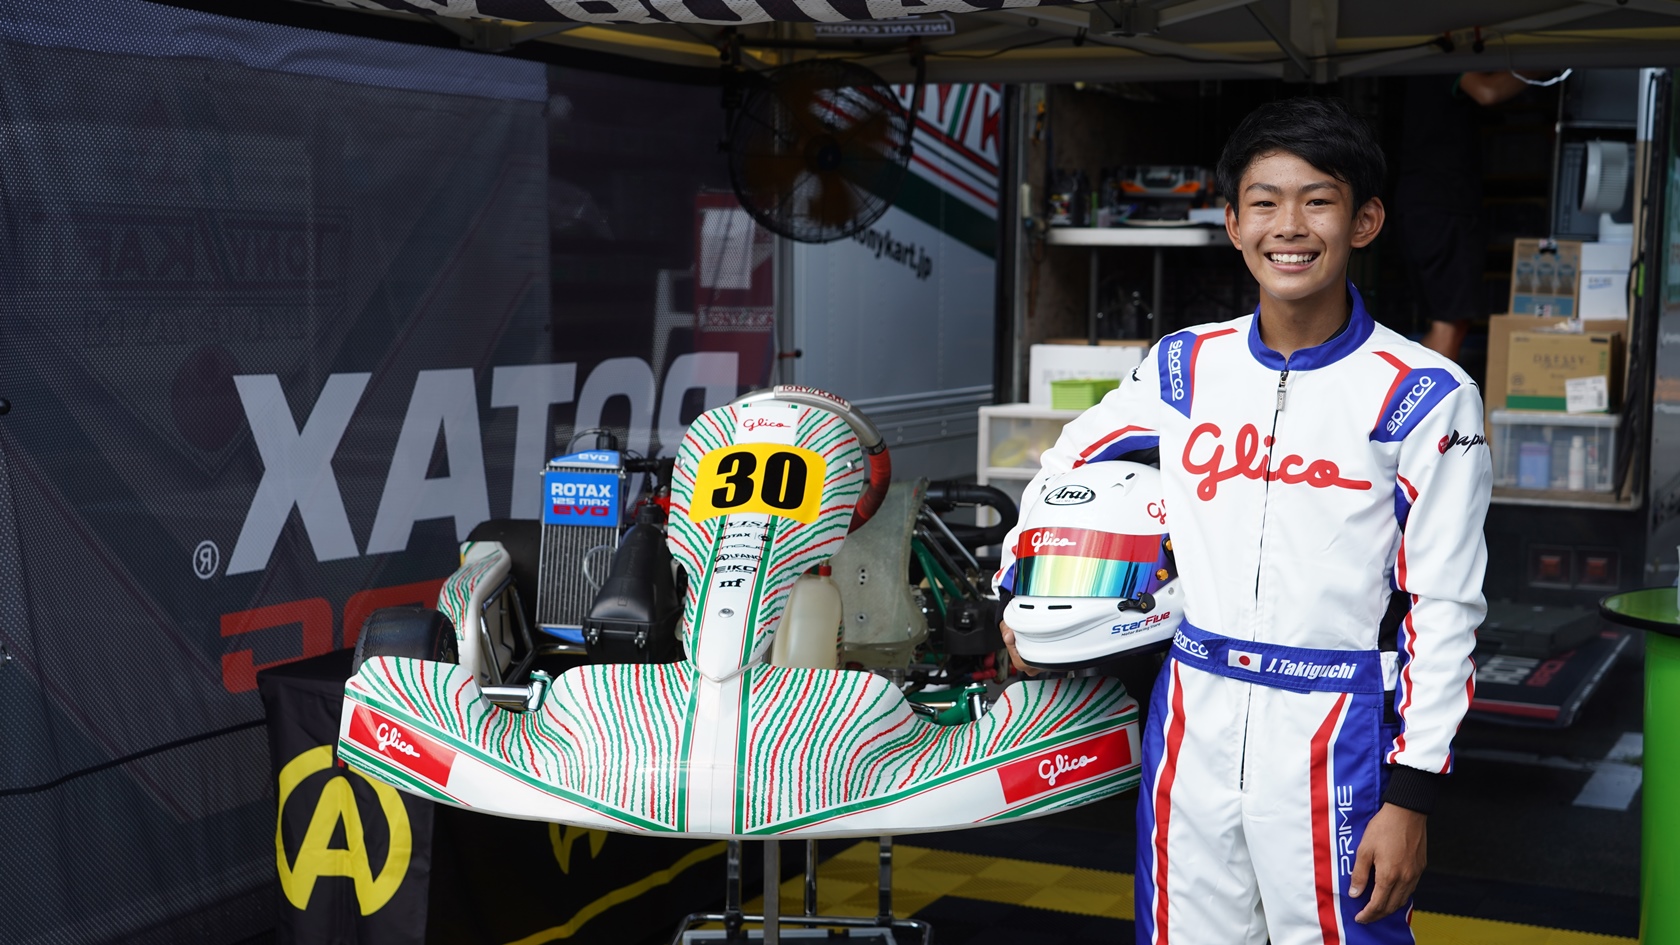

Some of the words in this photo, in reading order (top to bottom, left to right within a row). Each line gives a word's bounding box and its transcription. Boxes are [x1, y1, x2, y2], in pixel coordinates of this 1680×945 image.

[1168, 339, 1185, 401] sparco
[1386, 376, 1435, 434] sparco
[743, 418, 791, 432] Glico
[1182, 422, 1372, 502] Glico
[551, 482, 612, 498] ROTAX
[711, 451, 808, 510] 30
[552, 497, 576, 505] 125
[579, 498, 610, 507] MAX
[1052, 486, 1090, 500] Arai
[717, 533, 751, 541] ROTAX
[1031, 531, 1077, 553] Glico
[714, 565, 757, 573] EIKO
[719, 578, 746, 588] mf
[1174, 628, 1209, 658] sparco
[1266, 657, 1358, 680] J.Takiguchi
[376, 723, 421, 759] Glico
[1038, 754, 1098, 786] Glico
[1337, 785, 1354, 876] PRIME
